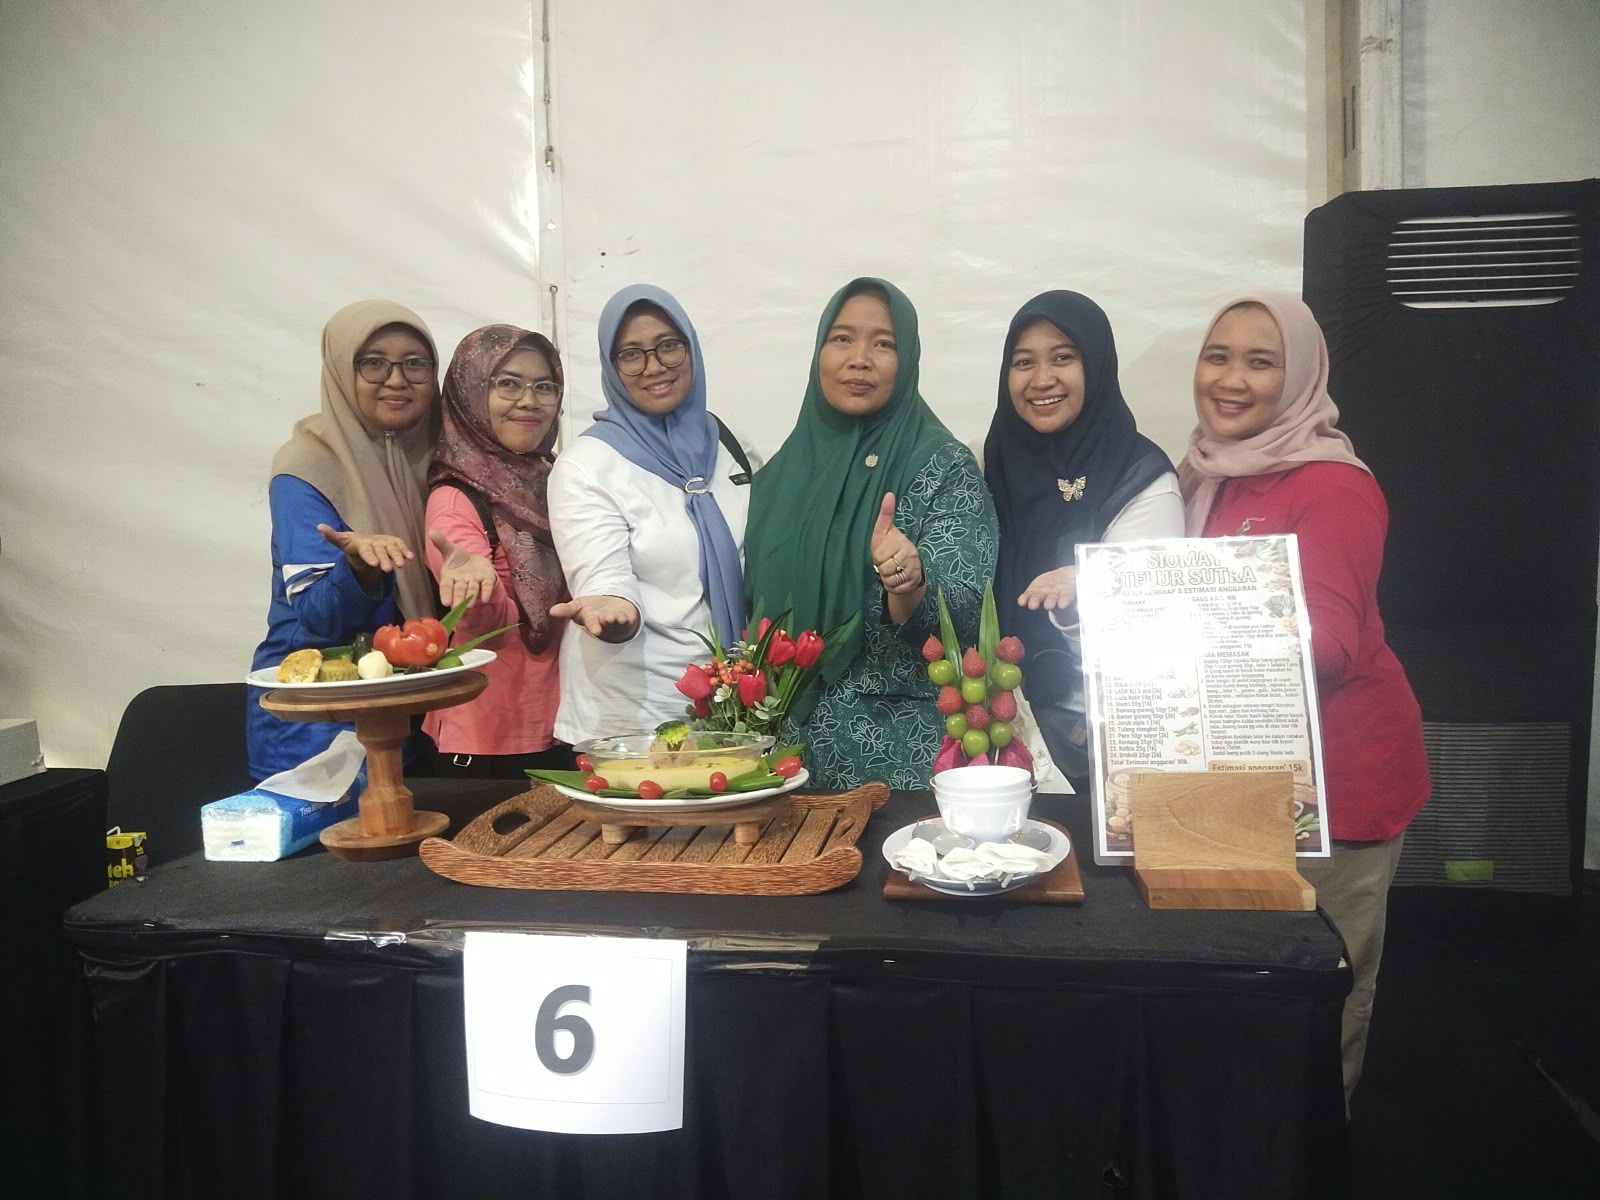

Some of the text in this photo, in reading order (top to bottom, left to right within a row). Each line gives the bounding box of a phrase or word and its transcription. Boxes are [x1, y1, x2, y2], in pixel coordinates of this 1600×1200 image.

[1120, 566, 1257, 588] TELUR SUTRA
[1288, 763, 1304, 772] 15k
[535, 984, 596, 1076] 6
